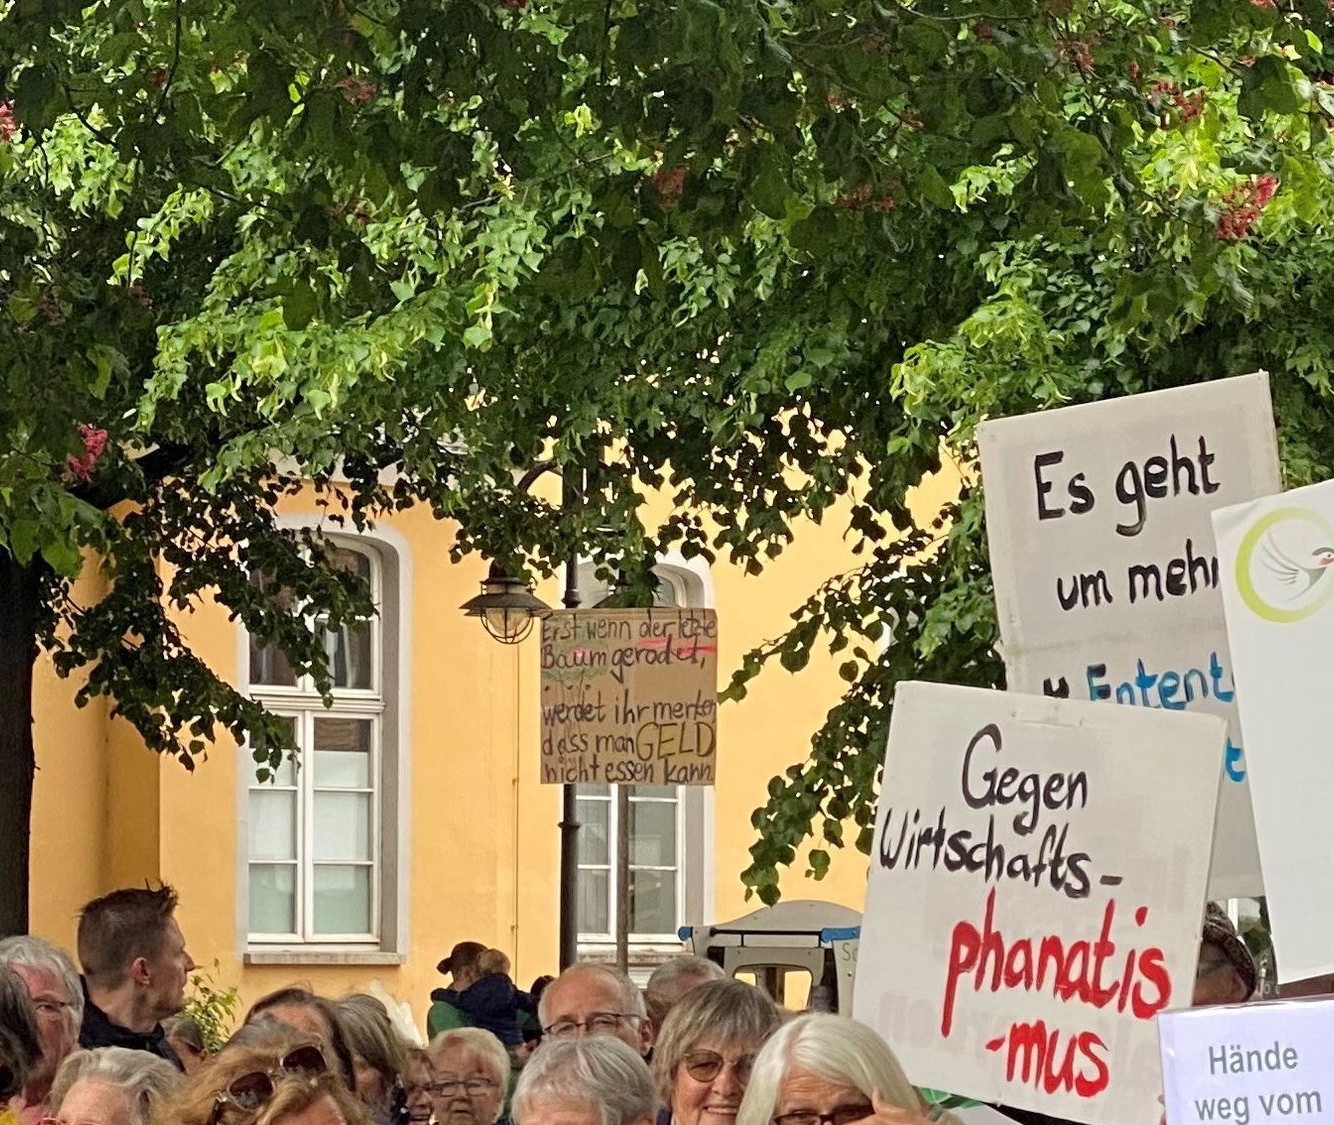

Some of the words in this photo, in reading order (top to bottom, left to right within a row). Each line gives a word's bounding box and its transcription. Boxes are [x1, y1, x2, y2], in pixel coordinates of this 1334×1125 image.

[1034, 450, 1095, 521] Es
[1115, 433, 1221, 537] geht
[1057, 569, 1113, 611] um
[542, 613, 581, 642] Erst
[586, 618, 632, 640] wenn
[639, 609, 675, 638] der
[677, 610, 716, 639] letzte
[541, 644, 607, 669] Baum
[610, 633, 706, 684] gerodet,
[542, 690, 606, 727] werdet
[615, 688, 650, 725] ihr
[543, 729, 589, 756] dass
[595, 734, 635, 753] man
[636, 721, 716, 762] GELD
[544, 754, 600, 784] nicht
[604, 760, 654, 784] essen
[962, 723, 1089, 836] Gegen
[879, 805, 1124, 899] Wirtschafts-
[940, 886, 1173, 1038] phanatis
[985, 1019, 1110, 1098] -mus
[1208, 1040, 1299, 1075] Hände
[1258, 1089, 1323, 1116] vom
